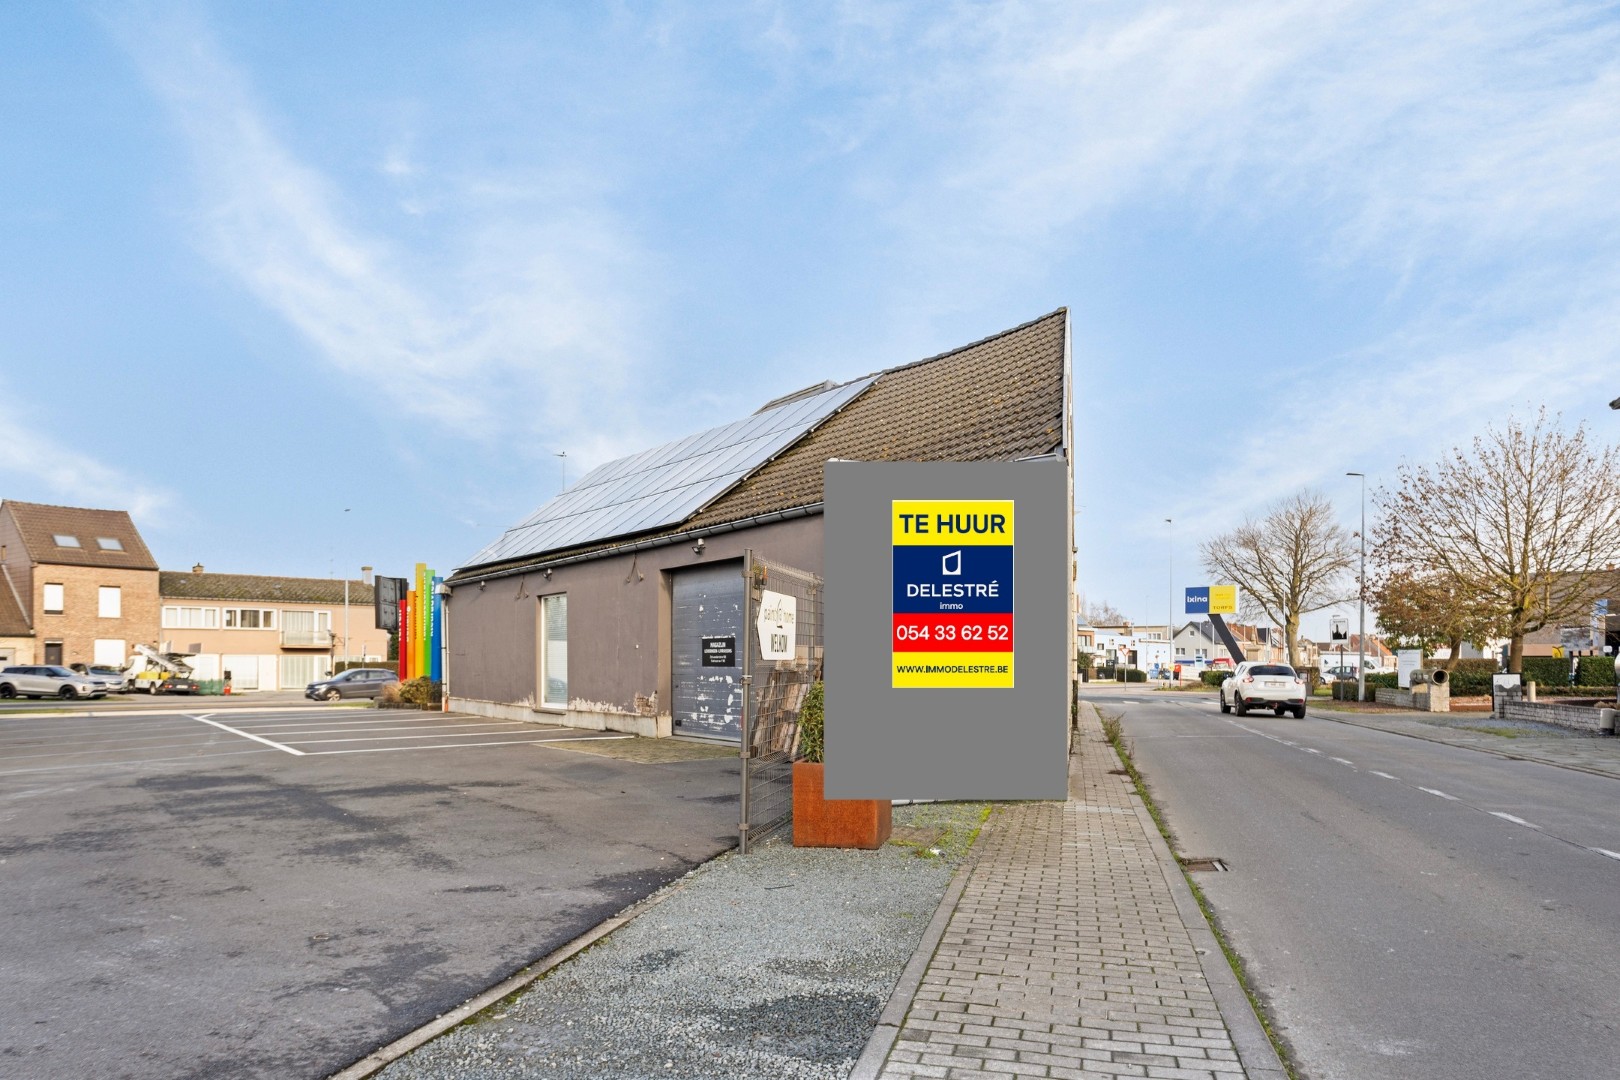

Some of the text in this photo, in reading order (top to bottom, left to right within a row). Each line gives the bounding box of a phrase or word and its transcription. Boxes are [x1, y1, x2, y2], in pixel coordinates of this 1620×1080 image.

[899, 514, 1005, 533] TE HUUR
[907, 580, 999, 597] DELESTRÉ
[939, 601, 964, 610] immo
[896, 625, 1008, 640] 054 33 62 52
[896, 664, 1008, 674] WWW.IMMODELESTRE.BE
